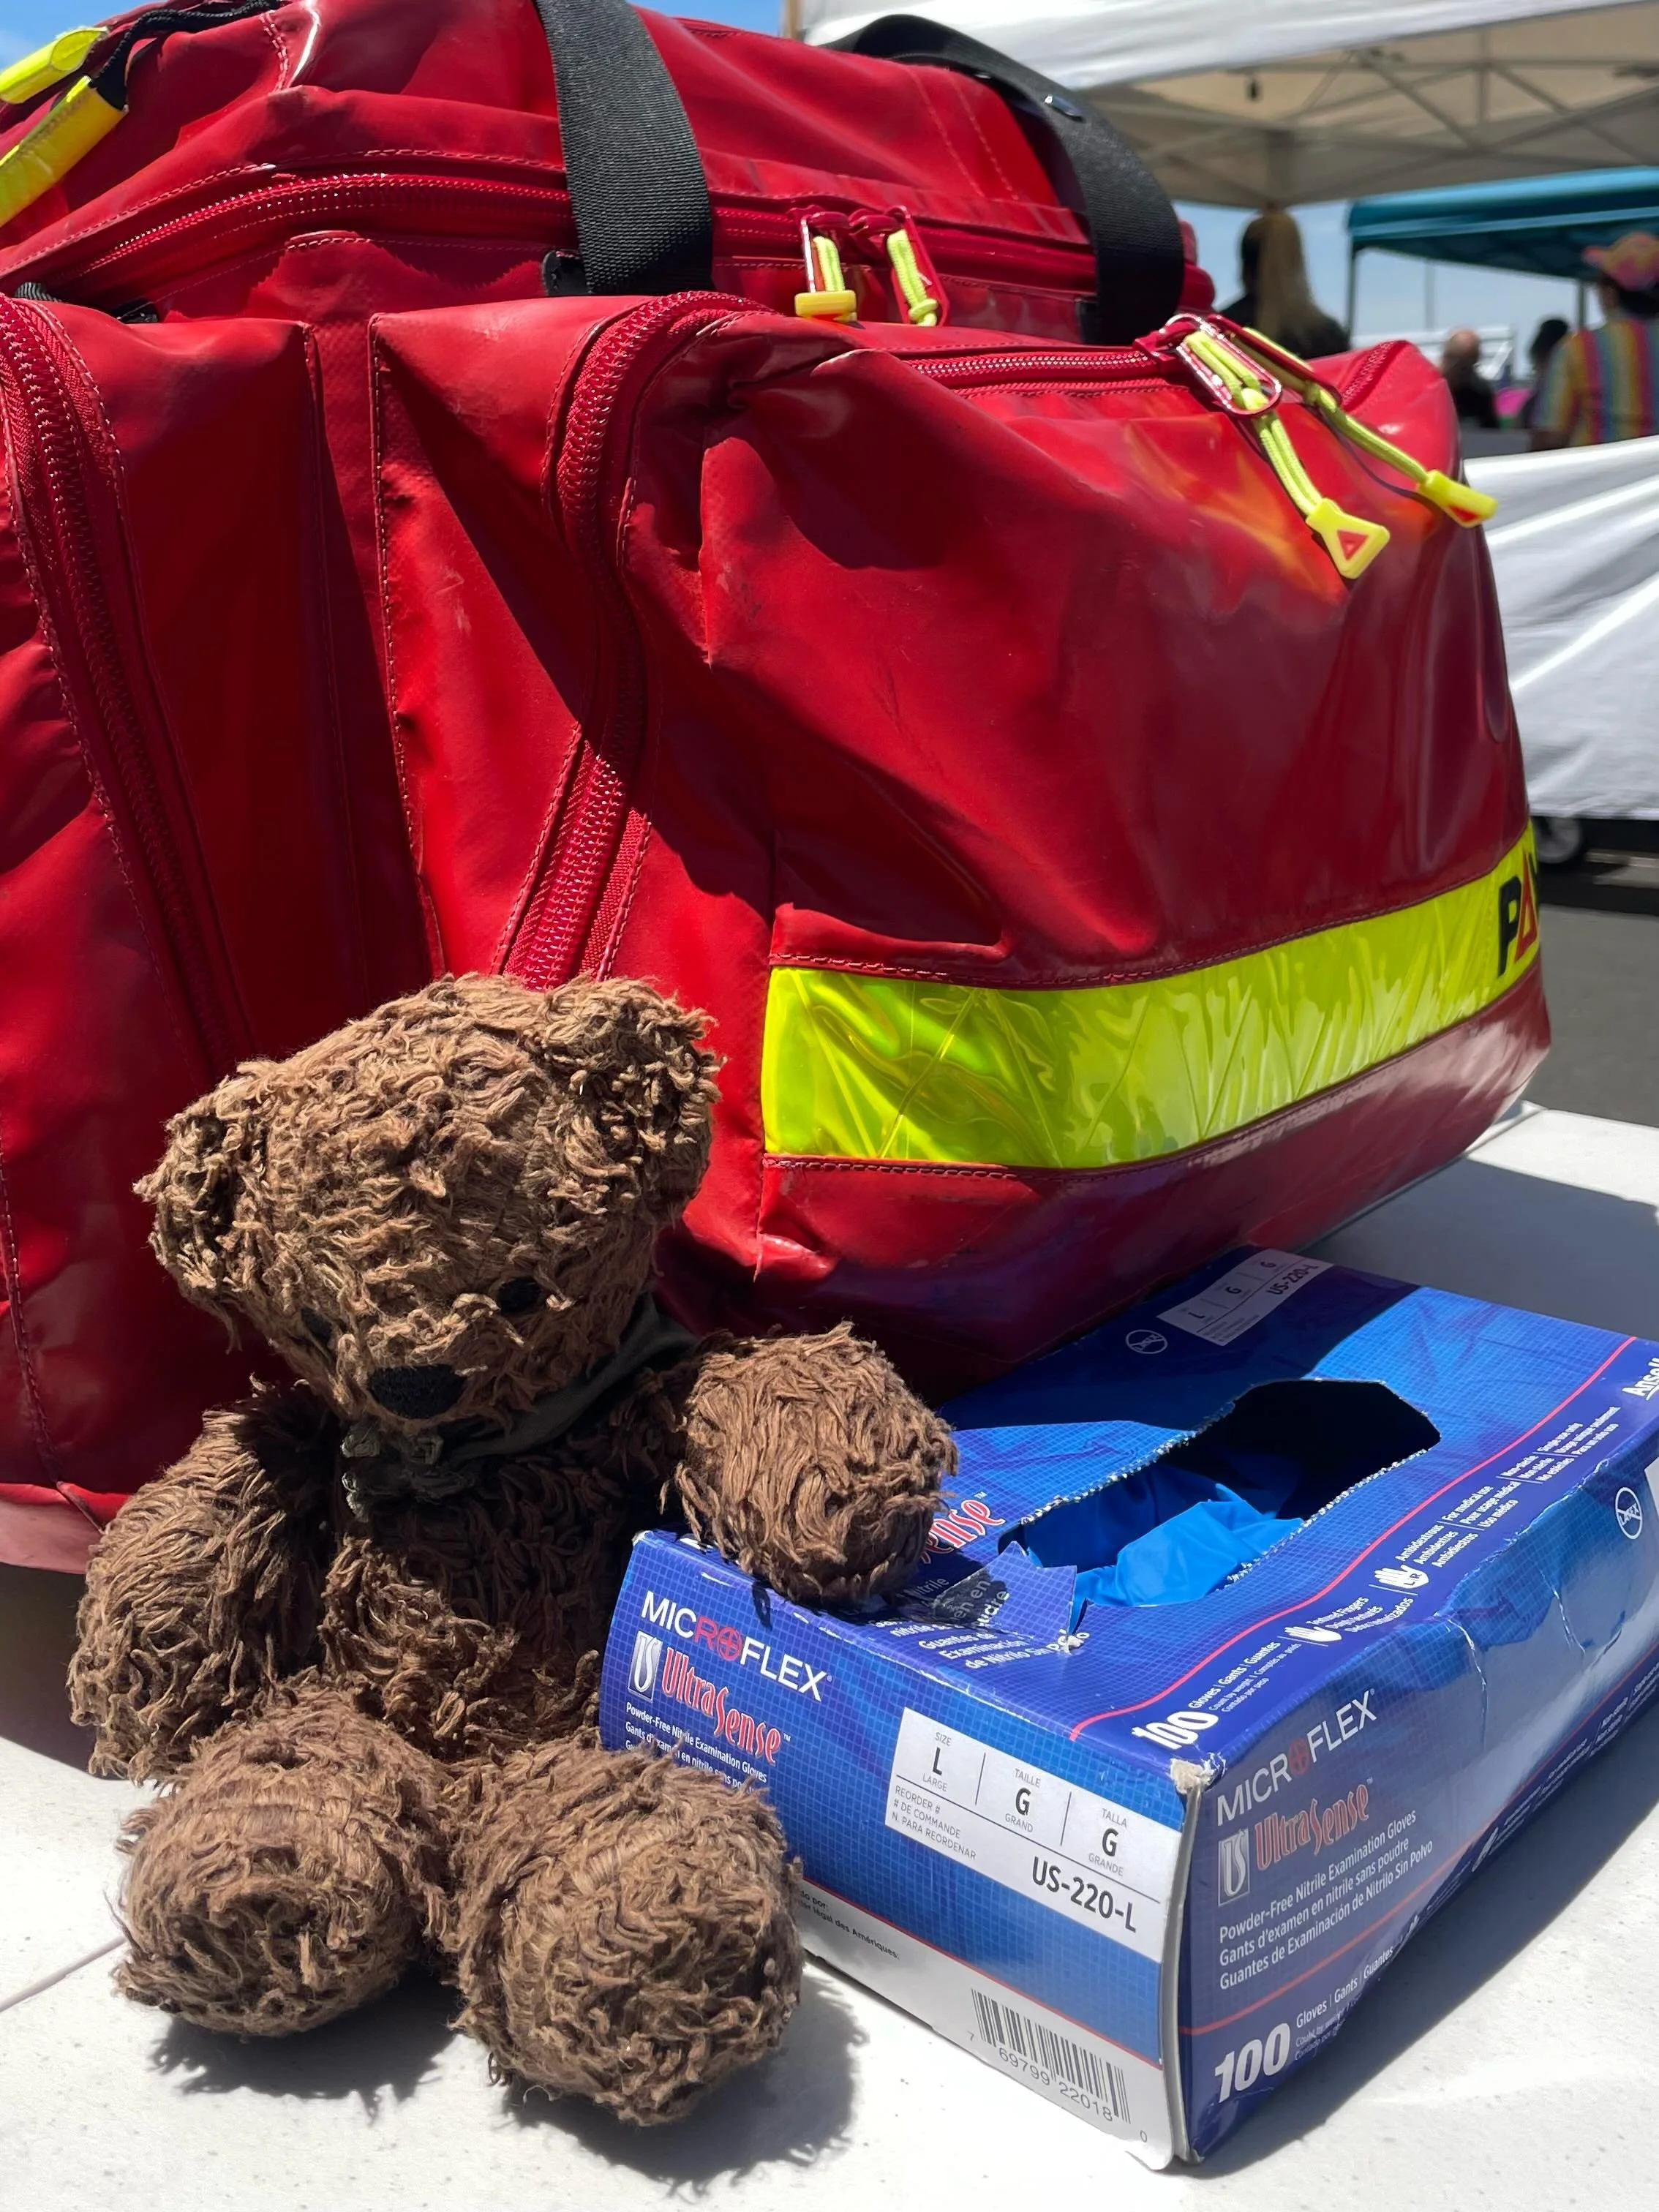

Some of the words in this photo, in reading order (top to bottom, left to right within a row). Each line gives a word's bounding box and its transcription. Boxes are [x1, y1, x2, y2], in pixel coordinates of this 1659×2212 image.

[1266, 1263, 1320, 1296] US-220-L
[919, 1635, 979, 1649] Guantes
[965, 1658, 988, 1669] de
[982, 1650, 1031, 1665] Nitrilo
[1188, 1687, 1222, 1709] Gloves
[1218, 1666, 1247, 1685] Gants
[1244, 1641, 1281, 1664] Guantes
[625, 1721, 645, 1740] Gants
[681, 1751, 691, 1764] en
[626, 1701, 671, 1734] Powder-Free
[672, 1725, 695, 1746] Nitile
[695, 1737, 741, 1769] Examination
[935, 1731, 952, 1748] SIZE
[1132, 1711, 1219, 1749] 100
[933, 1746, 943, 1776] L
[1015, 1767, 1042, 1789] TAILLE
[895, 1785, 933, 1810] REORDER
[922, 1773, 949, 1792] LARGE
[1015, 1787, 1031, 1816] G
[1101, 1807, 1128, 1828] TALLA
[900, 1802, 912, 1814] DE
[914, 1808, 961, 1840] COMMANDE
[902, 1816, 924, 1835] PARA
[925, 1828, 977, 1861] REORDENAR
[1004, 1813, 1034, 1834] GRAND
[1102, 1827, 1118, 1857] G
[1088, 1852, 1124, 1878] GRANDE
[1219, 1895, 1293, 1944] Powder-Free
[1295, 1871, 1327, 1903] Nitrile
[1328, 1833, 1386, 1881] Examination
[1386, 1810, 1417, 1840] Gloves
[1031, 1855, 1137, 1933] US-220-L
[1219, 1939, 1255, 1967] Gants
[1257, 1908, 1310, 1949] d'examen
[1312, 1897, 1323, 1916] en
[1325, 1877, 1353, 1908] nitrile
[1355, 1864, 1376, 1886] sans
[1378, 1837, 1410, 1871] poudre
[1219, 1955, 1274, 1990] Guantes
[1271, 1946, 1285, 1965] de
[1287, 1903, 1350, 1955] Examinación
[1352, 1892, 1364, 1911] de
[1366, 1871, 1393, 1902] Nitrilo
[1395, 1860, 1409, 1879] Sin
[1410, 1840, 1433, 1867] Polvo
[1296, 2000, 1328, 2028] Gloves
[1334, 1976, 1358, 2003] Gants
[1363, 1946, 1393, 1979] Guantes
[1214, 2023, 1290, 2104] 100
[967, 2031, 975, 2042] 7
[999, 2047, 1051, 2086] 69799
[1058, 2081, 1113, 2122] 22018
[1140, 2129, 1148, 2143] 0
